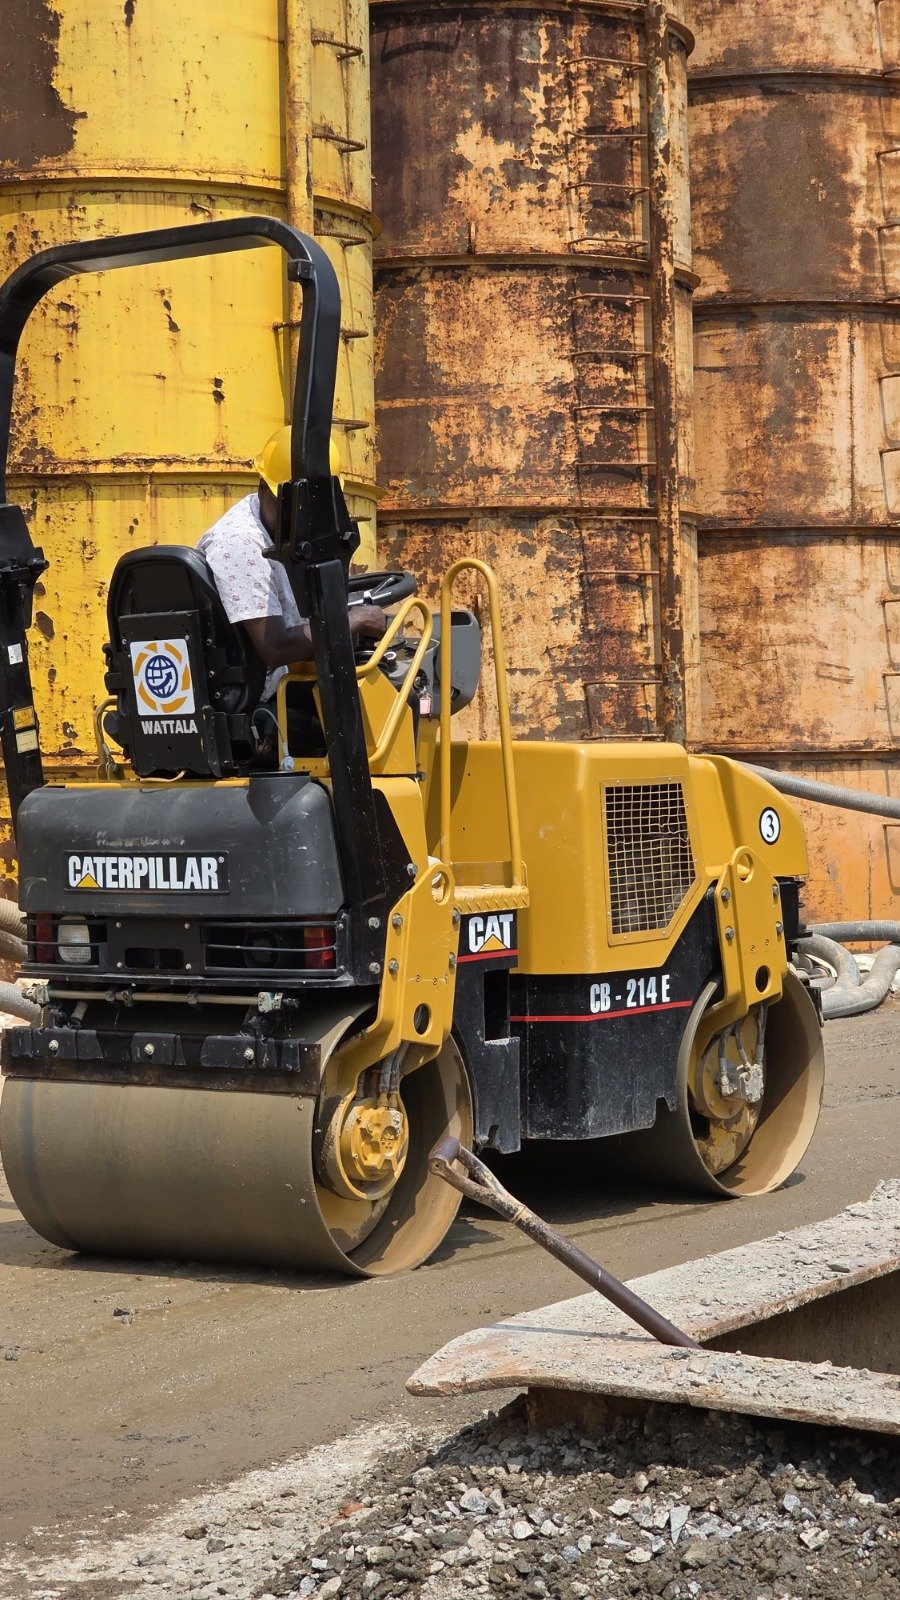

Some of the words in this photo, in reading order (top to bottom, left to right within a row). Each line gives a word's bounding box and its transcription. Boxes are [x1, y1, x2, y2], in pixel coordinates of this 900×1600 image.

[141, 720, 198, 734] WATTALA
[766, 814, 775, 838] 3
[68, 855, 219, 889] CATERPILLAR
[468, 914, 514, 953] CAT
